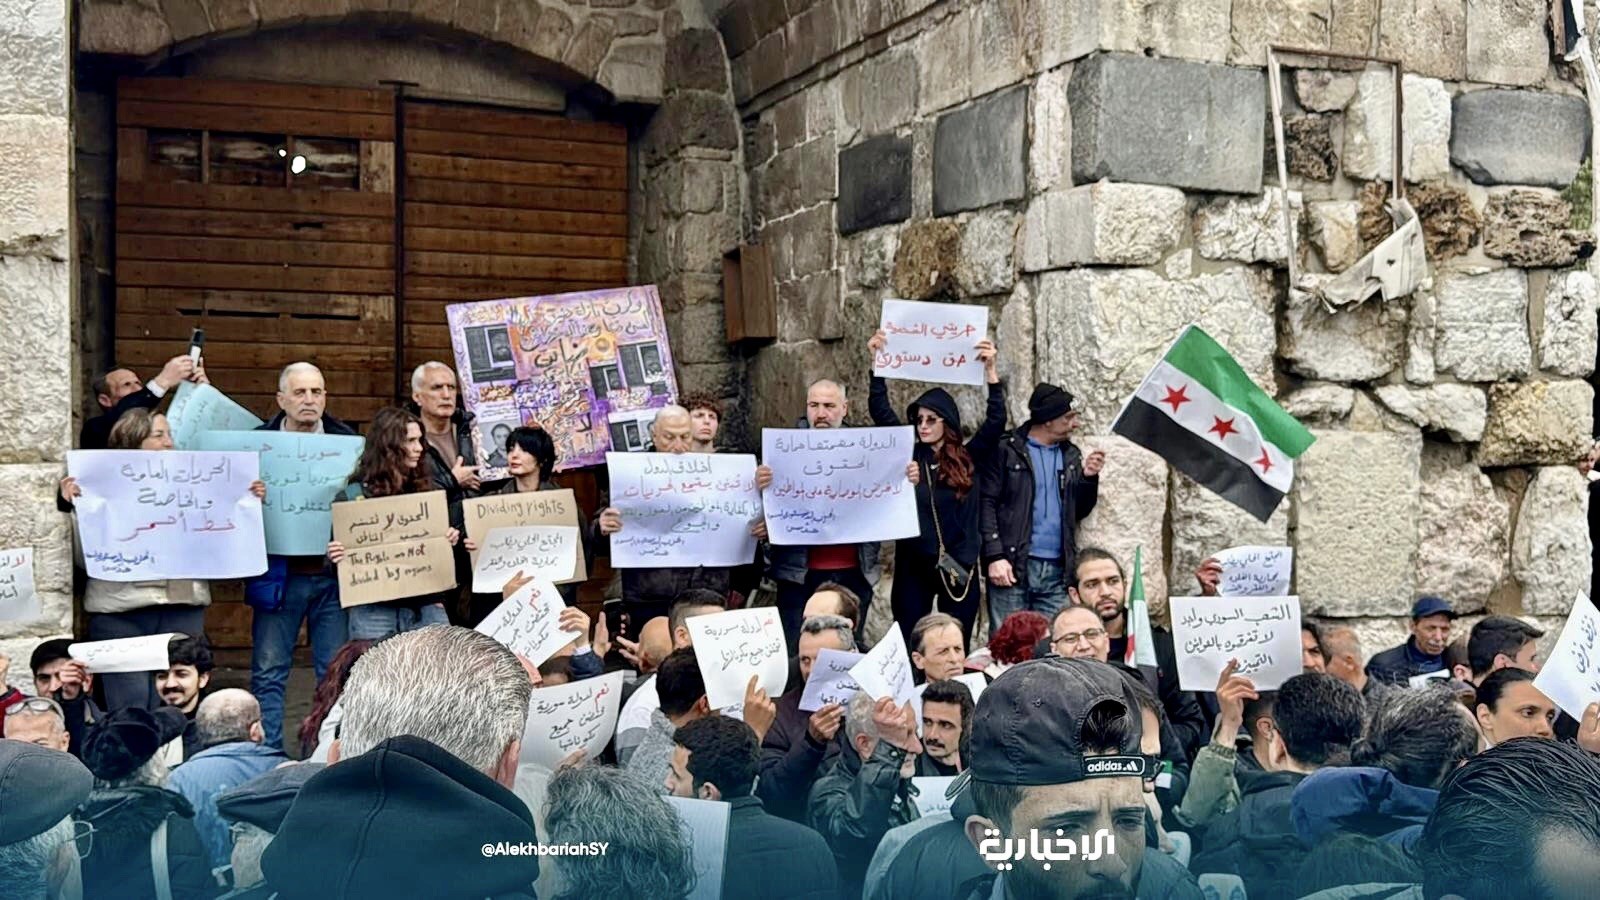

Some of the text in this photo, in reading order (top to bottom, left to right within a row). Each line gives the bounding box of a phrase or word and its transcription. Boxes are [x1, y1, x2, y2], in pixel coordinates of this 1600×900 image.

[930, 321, 976, 340] حريتي
[876, 350, 967, 369] حق دستوري
[297, 436, 342, 462] سوريا
[807, 433, 856, 451] مهمتها
[859, 433, 896, 450] الدولة
[120, 456, 232, 484] الحريات العامة
[802, 454, 870, 477] الحقوق
[137, 486, 214, 509] والخاصة
[623, 474, 678, 501] الحريات
[396, 502, 430, 527] الحقوق
[476, 499, 566, 519] Dividing rights
[114, 510, 237, 543] خط أحمر
[382, 512, 396, 531] لا
[385, 566, 401, 581] by
[1180, 603, 1291, 629] الشعب السوري واحد
[704, 624, 739, 641] سورية
[594, 682, 610, 713] نعم
[1087, 760, 1122, 773] adidas
